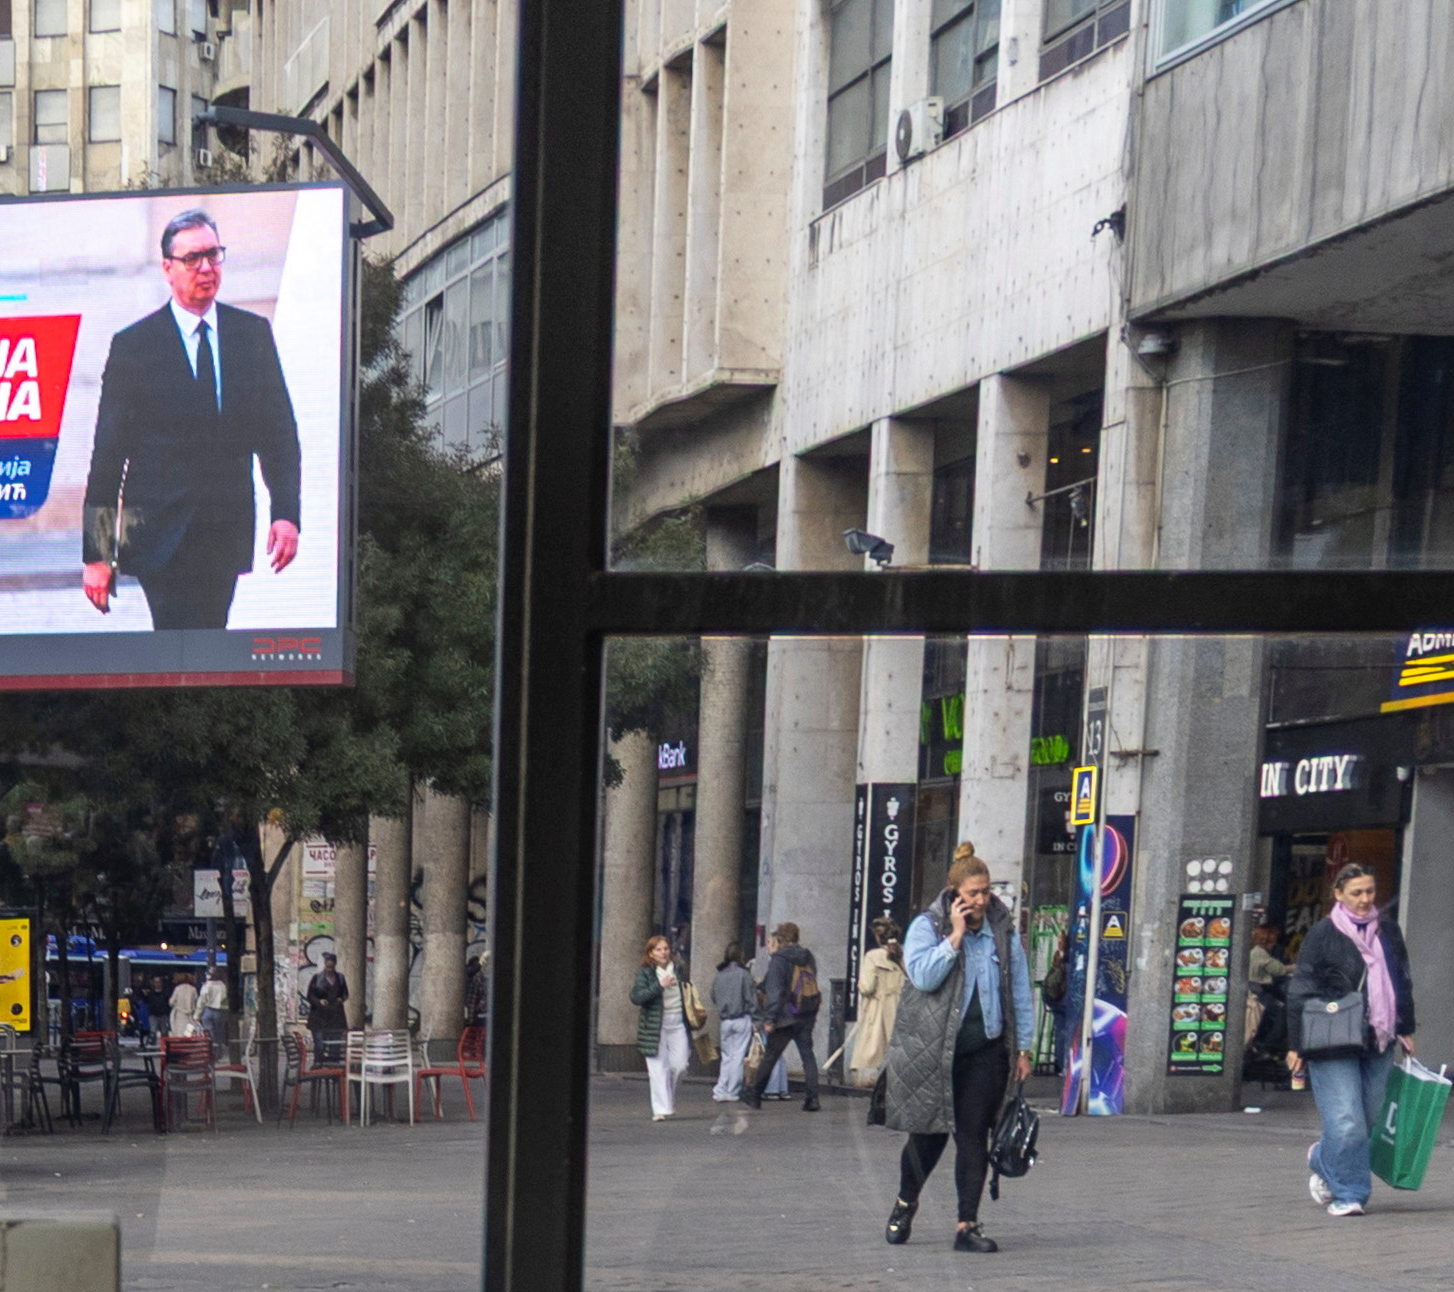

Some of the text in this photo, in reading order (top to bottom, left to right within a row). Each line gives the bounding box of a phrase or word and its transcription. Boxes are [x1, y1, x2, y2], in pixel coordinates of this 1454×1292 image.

[1260, 754, 1355, 797] IN CITY
[881, 824, 900, 904] GYROS
